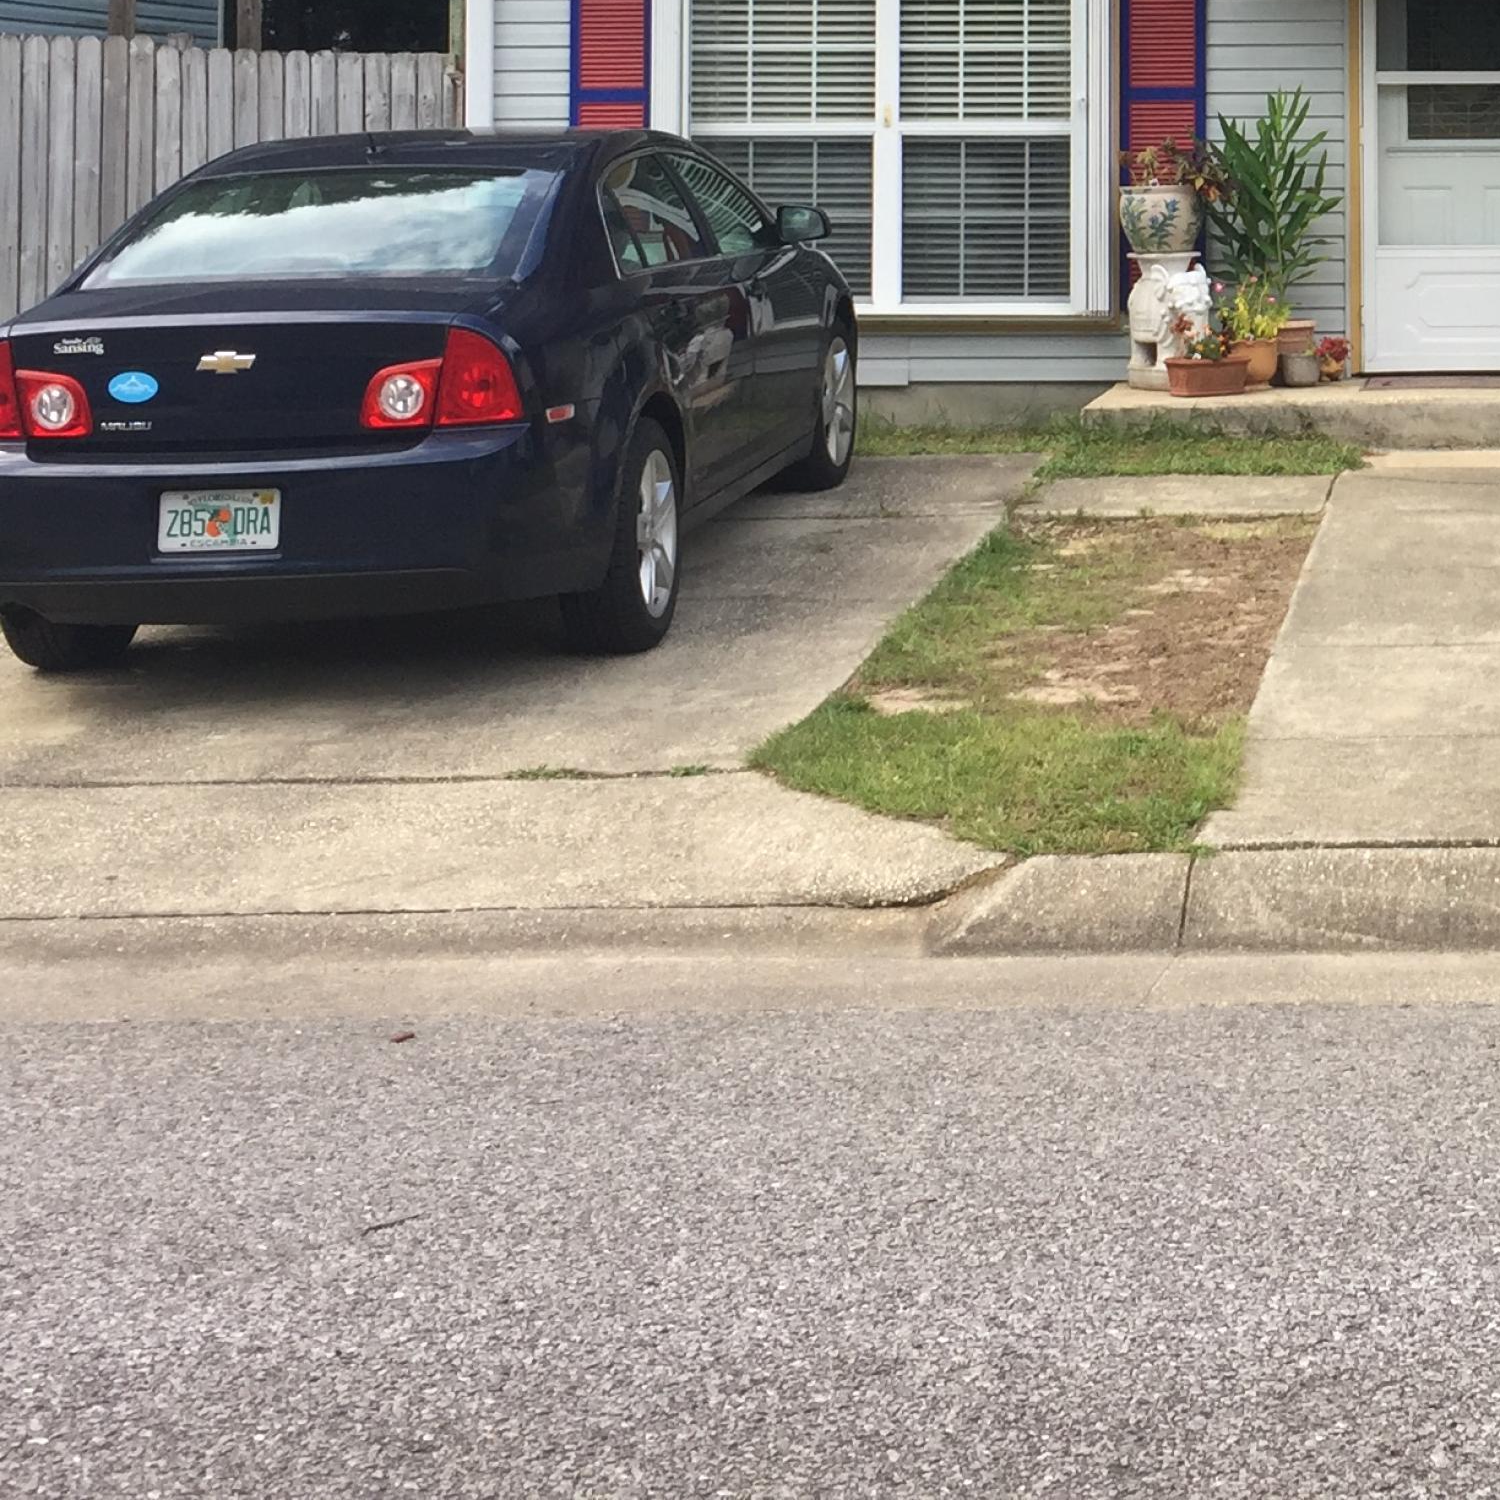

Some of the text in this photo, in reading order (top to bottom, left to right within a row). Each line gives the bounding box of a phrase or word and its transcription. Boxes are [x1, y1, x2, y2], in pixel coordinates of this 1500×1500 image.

[53, 342, 104, 355] Sansing
[166, 506, 272, 538] Z85 DRA
